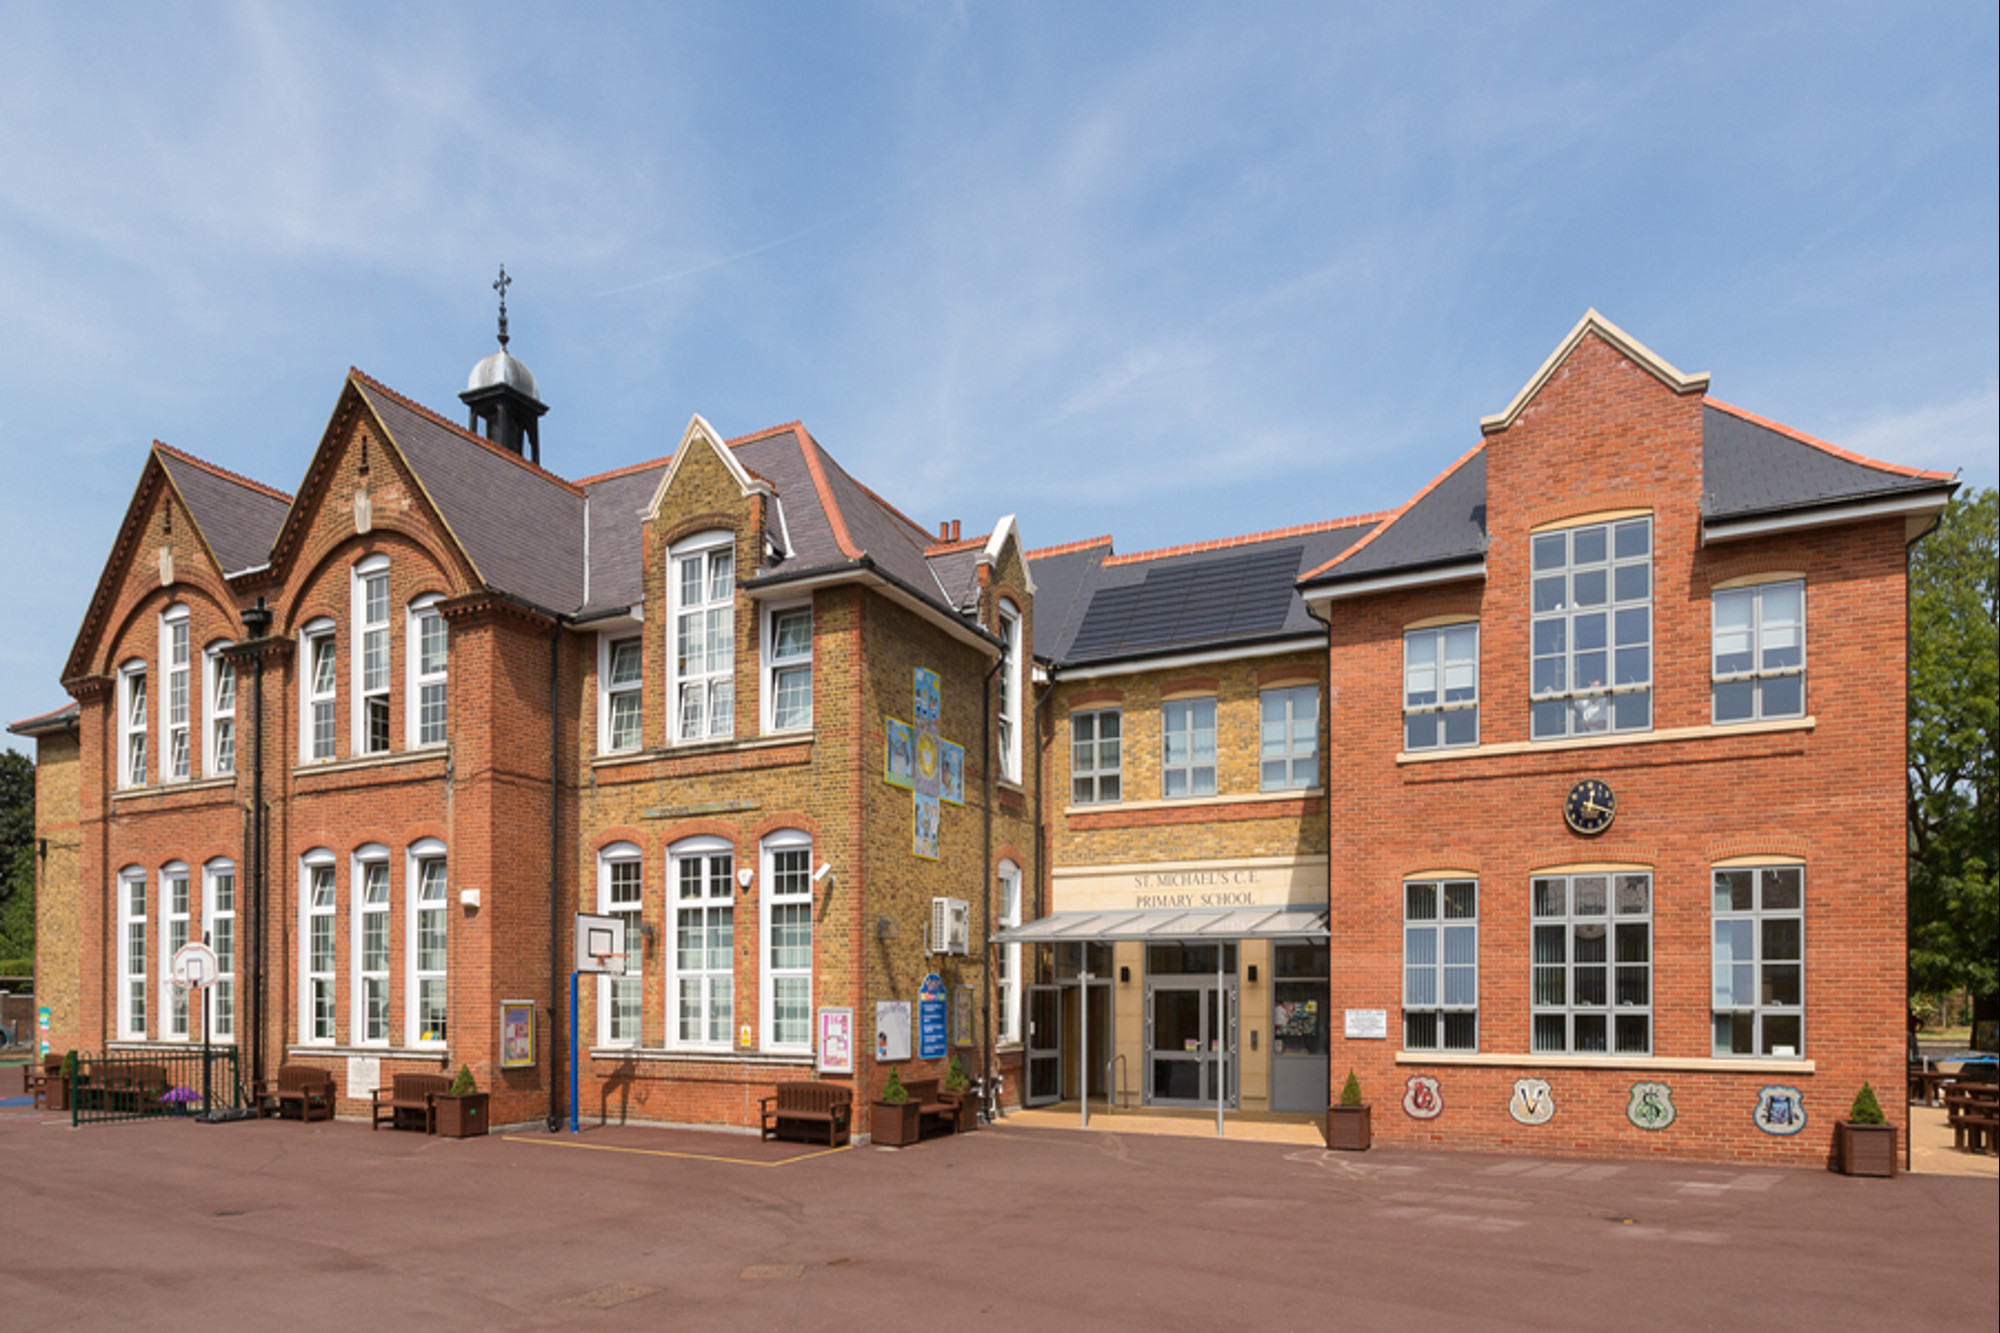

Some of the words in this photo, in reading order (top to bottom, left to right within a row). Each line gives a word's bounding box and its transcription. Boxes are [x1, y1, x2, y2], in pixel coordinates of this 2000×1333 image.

[1134, 874, 1153, 888] ST.
[1156, 871, 1229, 887] MICHAEL'S
[1136, 894, 1193, 908] PRIMARY
[1200, 892, 1255, 906] SCHOOL
[1519, 1087, 1544, 1115] V
